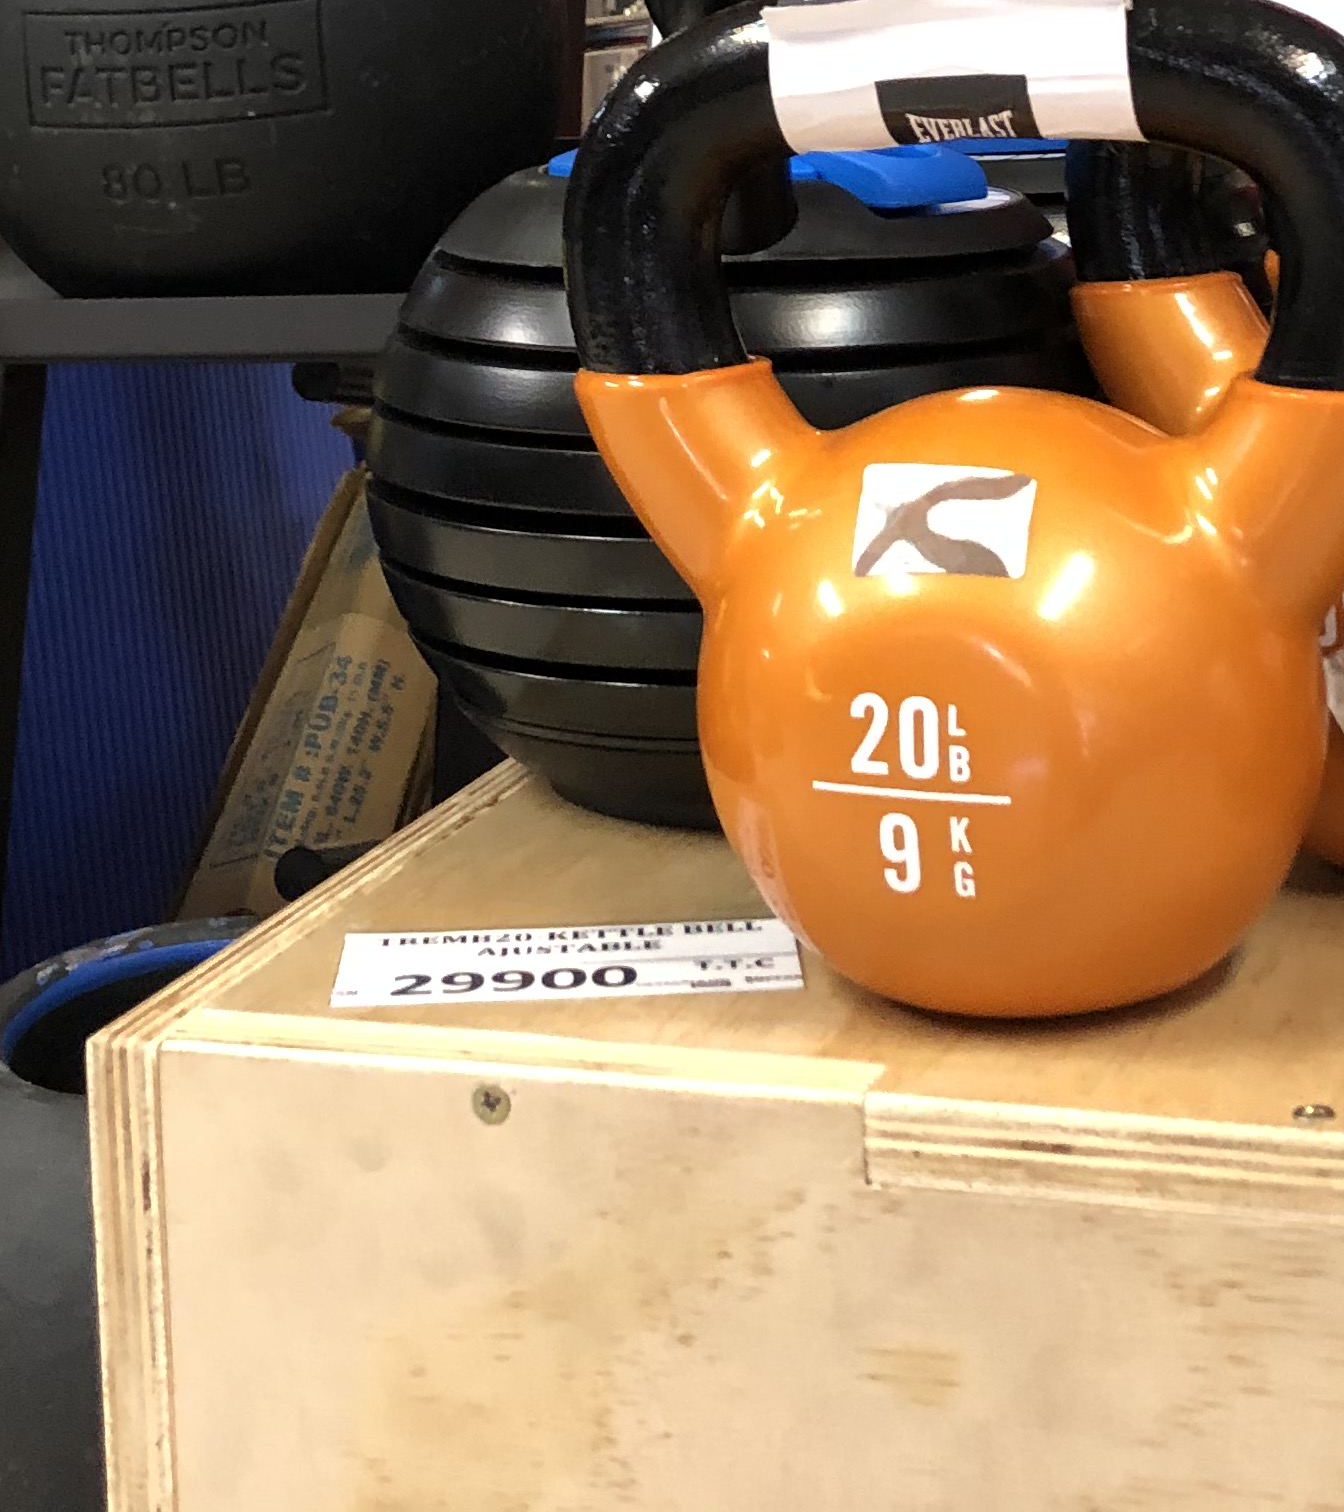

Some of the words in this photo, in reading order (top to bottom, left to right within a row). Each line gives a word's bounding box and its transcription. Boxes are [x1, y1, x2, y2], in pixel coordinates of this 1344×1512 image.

[64, 19, 268, 57] THOMPSON
[41, 50, 307, 106] FATBELLS
[905, 110, 1016, 144] EVERLAST
[102, 162, 161, 204] 80
[182, 157, 251, 201] LB
[849, 691, 940, 780] 20
[879, 812, 921, 894] 9
[477, 939, 663, 957] AJUSTABLE
[548, 923, 675, 942] KETTLE
[683, 920, 763, 937] BELL
[390, 964, 638, 997] 29900
